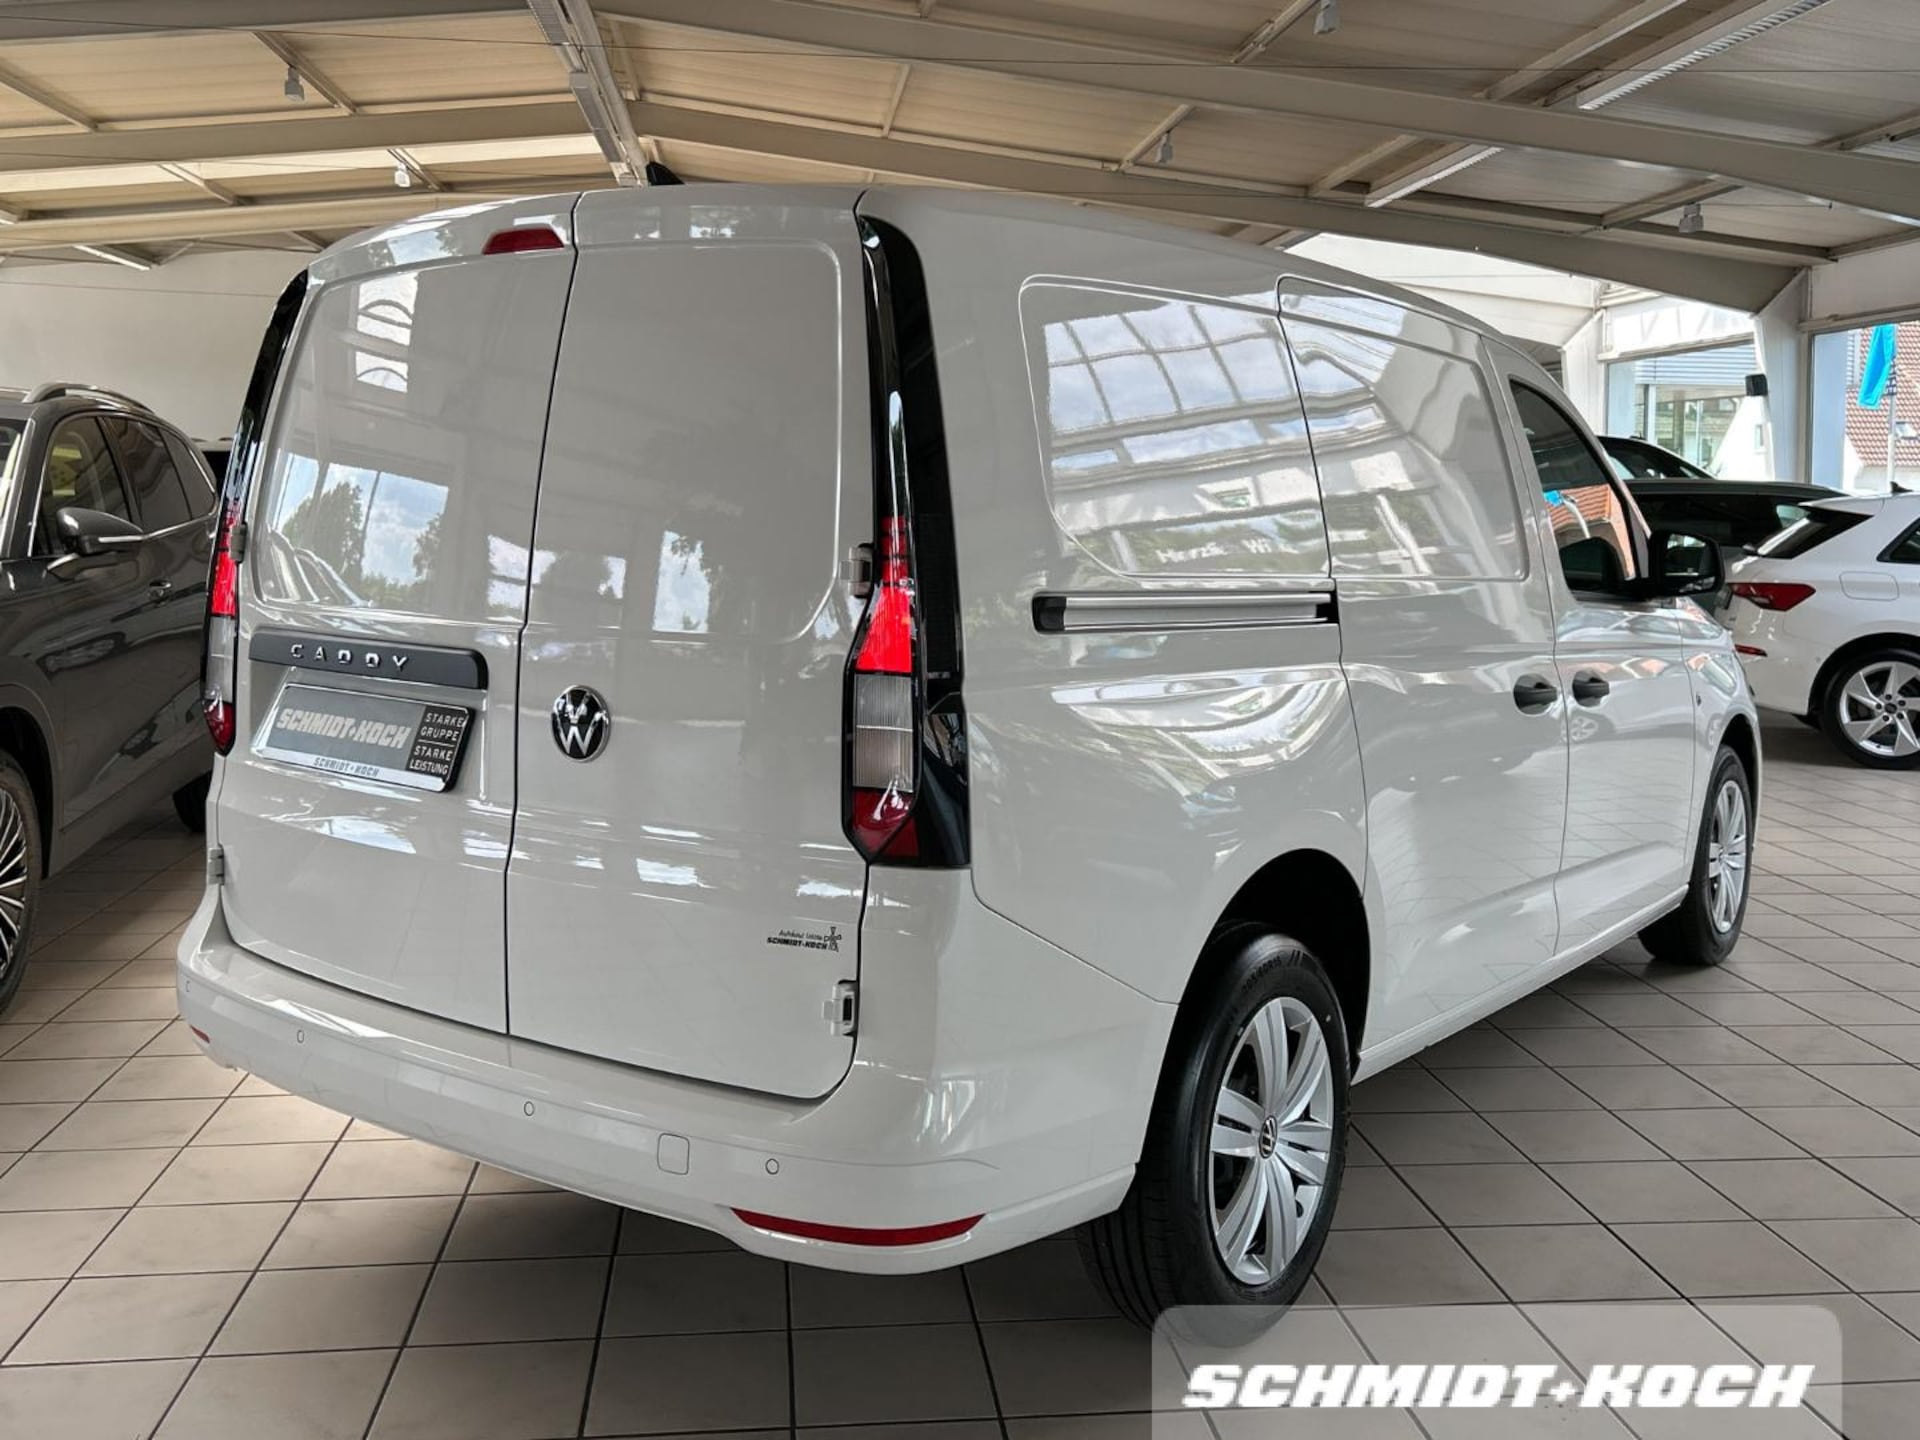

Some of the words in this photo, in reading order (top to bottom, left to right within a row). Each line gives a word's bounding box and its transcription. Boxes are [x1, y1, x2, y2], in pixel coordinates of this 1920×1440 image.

[291, 643, 407, 670] CADDY
[425, 712, 466, 727] STARKE
[276, 708, 412, 750] SCHMIDT+KOCH
[420, 726, 459, 741] GRUPPE
[413, 745, 453, 761] STARKE
[409, 759, 449, 775] LEISTUNG
